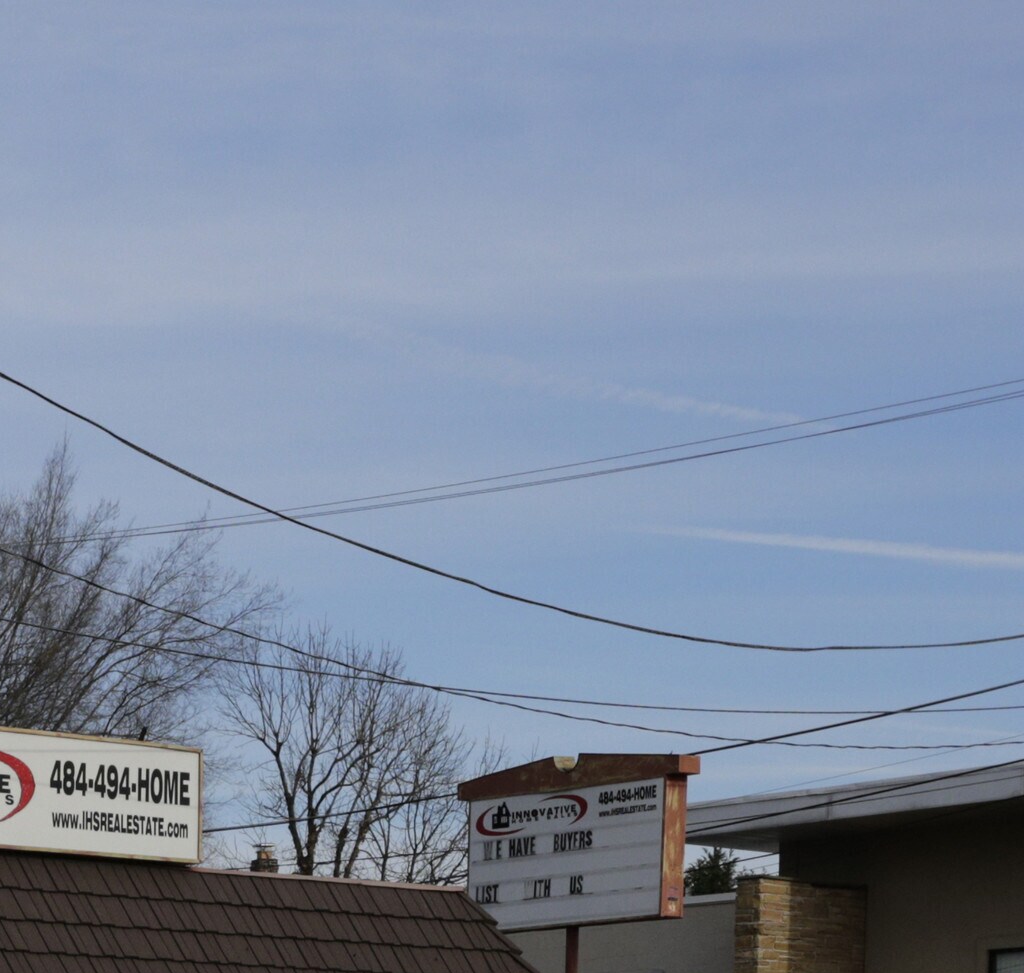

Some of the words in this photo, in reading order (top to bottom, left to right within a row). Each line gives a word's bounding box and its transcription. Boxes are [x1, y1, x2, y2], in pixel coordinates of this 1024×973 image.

[49, 760, 191, 806] 484-494-HOME
[598, 785, 657, 805] 484-494-HOME
[511, 803, 577, 820] INNOVATIVE
[51, 811, 189, 839] www.IHSREALESTATE.com
[509, 836, 536, 858] HAVE
[475, 884, 499, 904] LIST
[570, 875, 584, 894] US
